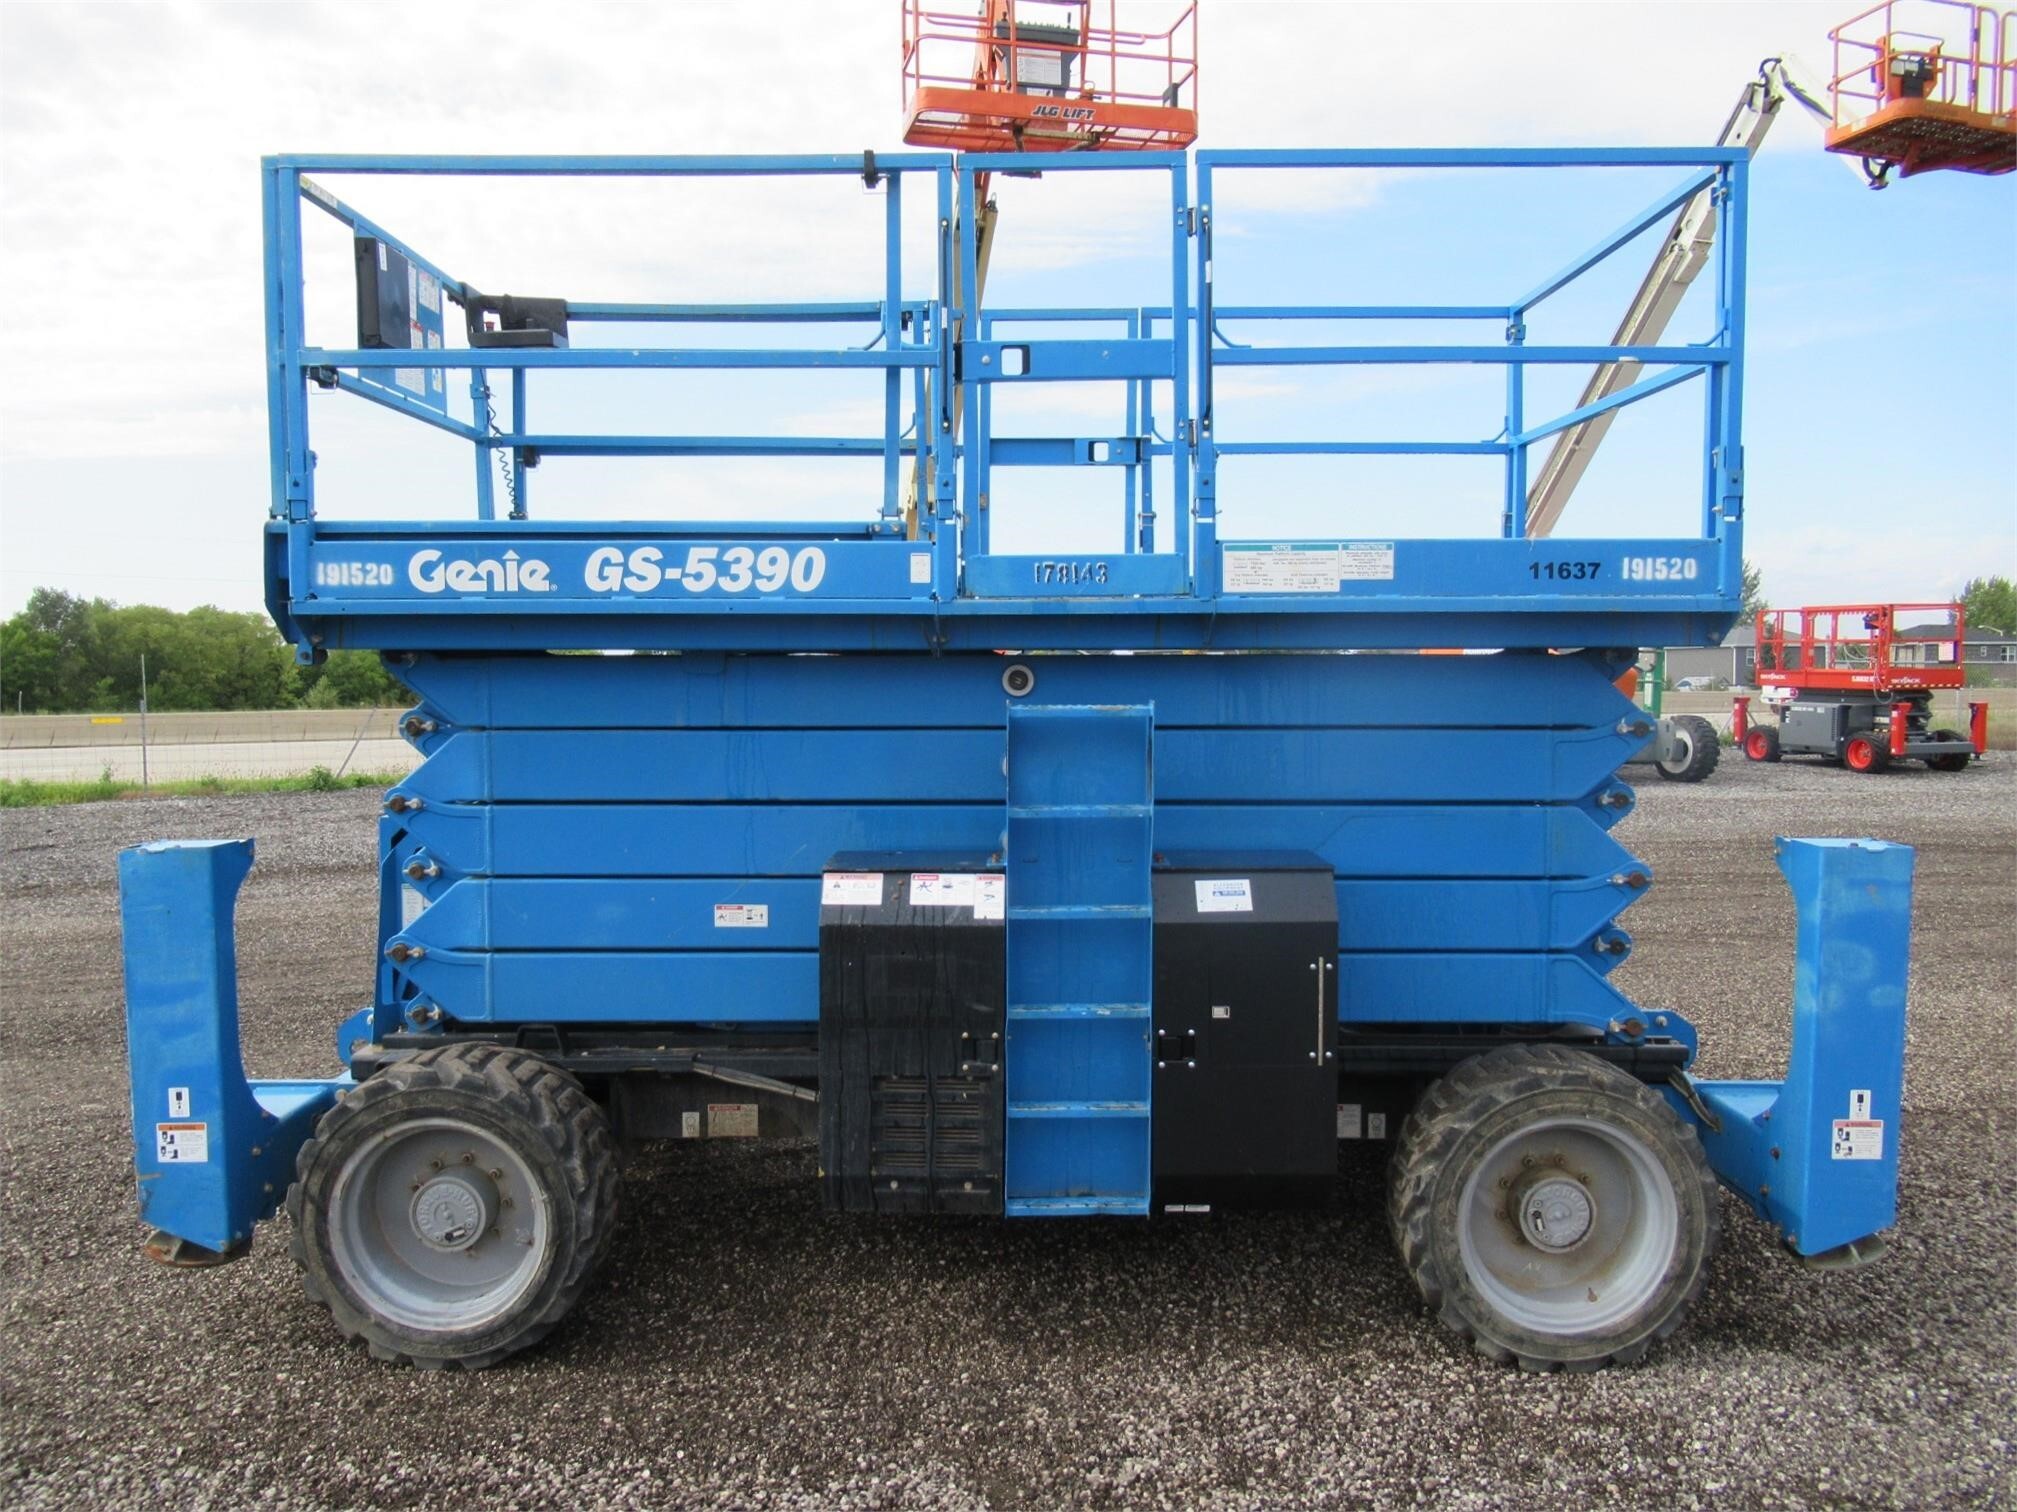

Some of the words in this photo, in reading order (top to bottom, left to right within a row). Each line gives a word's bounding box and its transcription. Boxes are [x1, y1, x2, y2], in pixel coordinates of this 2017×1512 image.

[1032, 104, 1060, 117] JLG
[1062, 107, 1095, 120] LIFT
[316, 561, 394, 586] 191520
[408, 549, 550, 593] Genie
[584, 546, 827, 592] GS-5390
[1034, 560, 1109, 584] 178143
[1529, 561, 1601, 580] 11637
[1622, 557, 1698, 581] 191520
